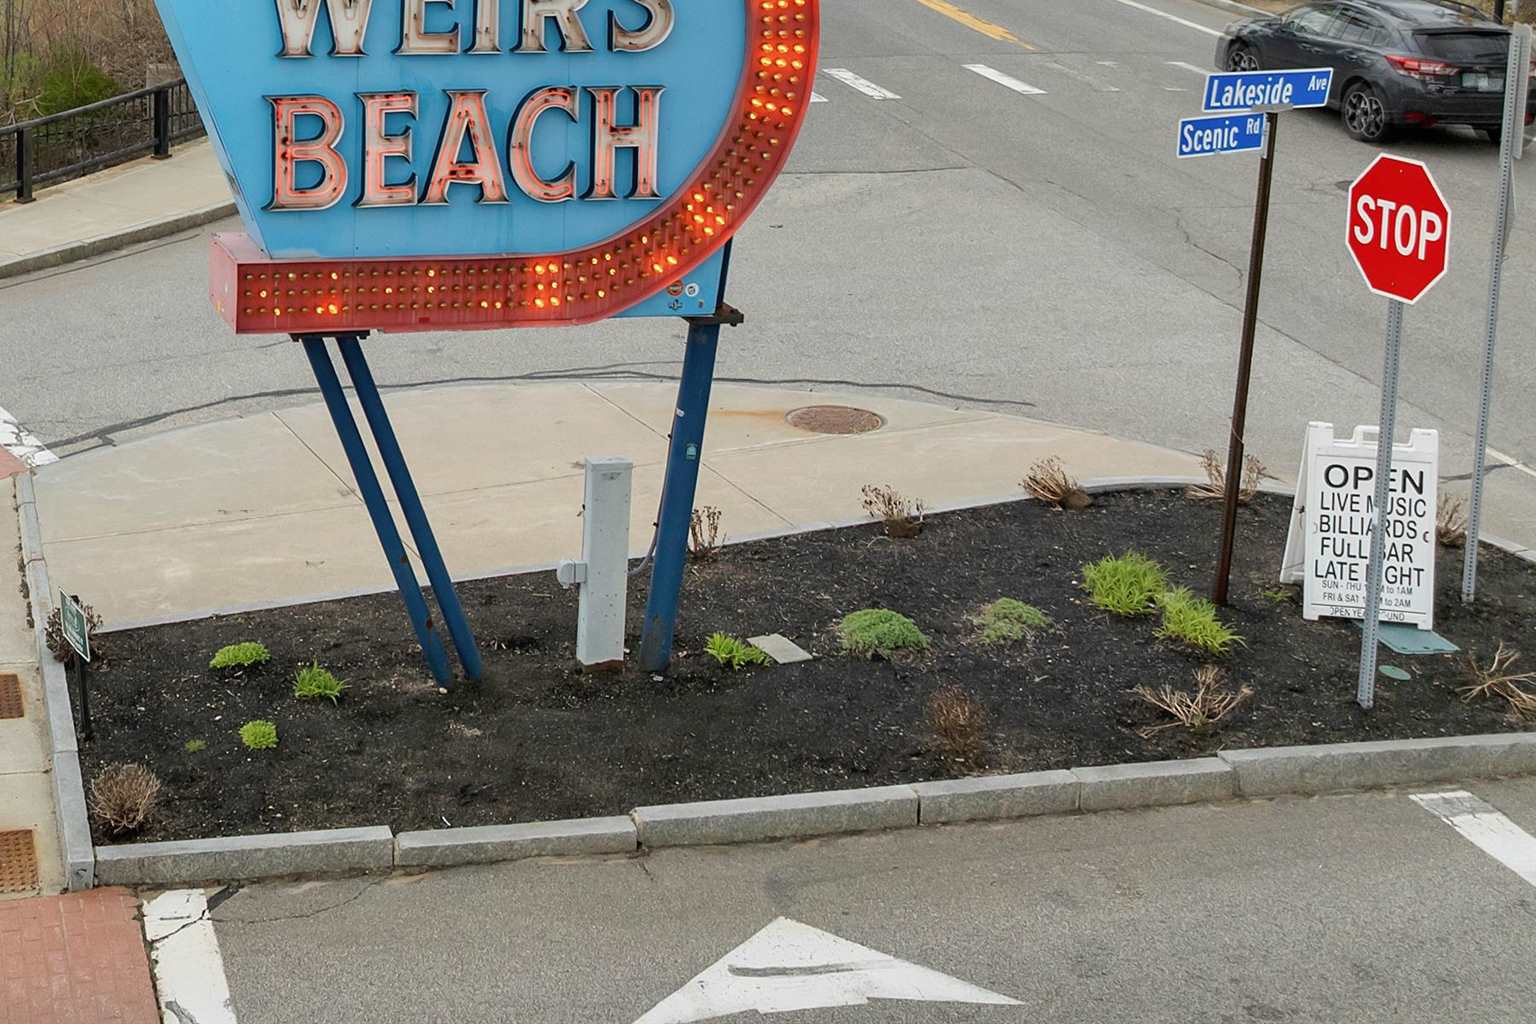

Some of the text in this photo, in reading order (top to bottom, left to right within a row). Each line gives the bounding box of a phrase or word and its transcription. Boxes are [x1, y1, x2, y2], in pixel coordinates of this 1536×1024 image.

[1209, 75, 1328, 107] Lakeside Ave
[263, 84, 667, 211] BEACH
[1181, 117, 1260, 153] Scenic Rd
[1353, 194, 1443, 261] STOP
[1320, 491, 1361, 513] LIVE
[1320, 537, 1414, 564] FULL AR
[1315, 560, 1425, 588] LATE GHT
[1322, 580, 1339, 589] SUN
[1323, 592, 1336, 602] FRI
[1394, 598, 1411, 607] 2AM
